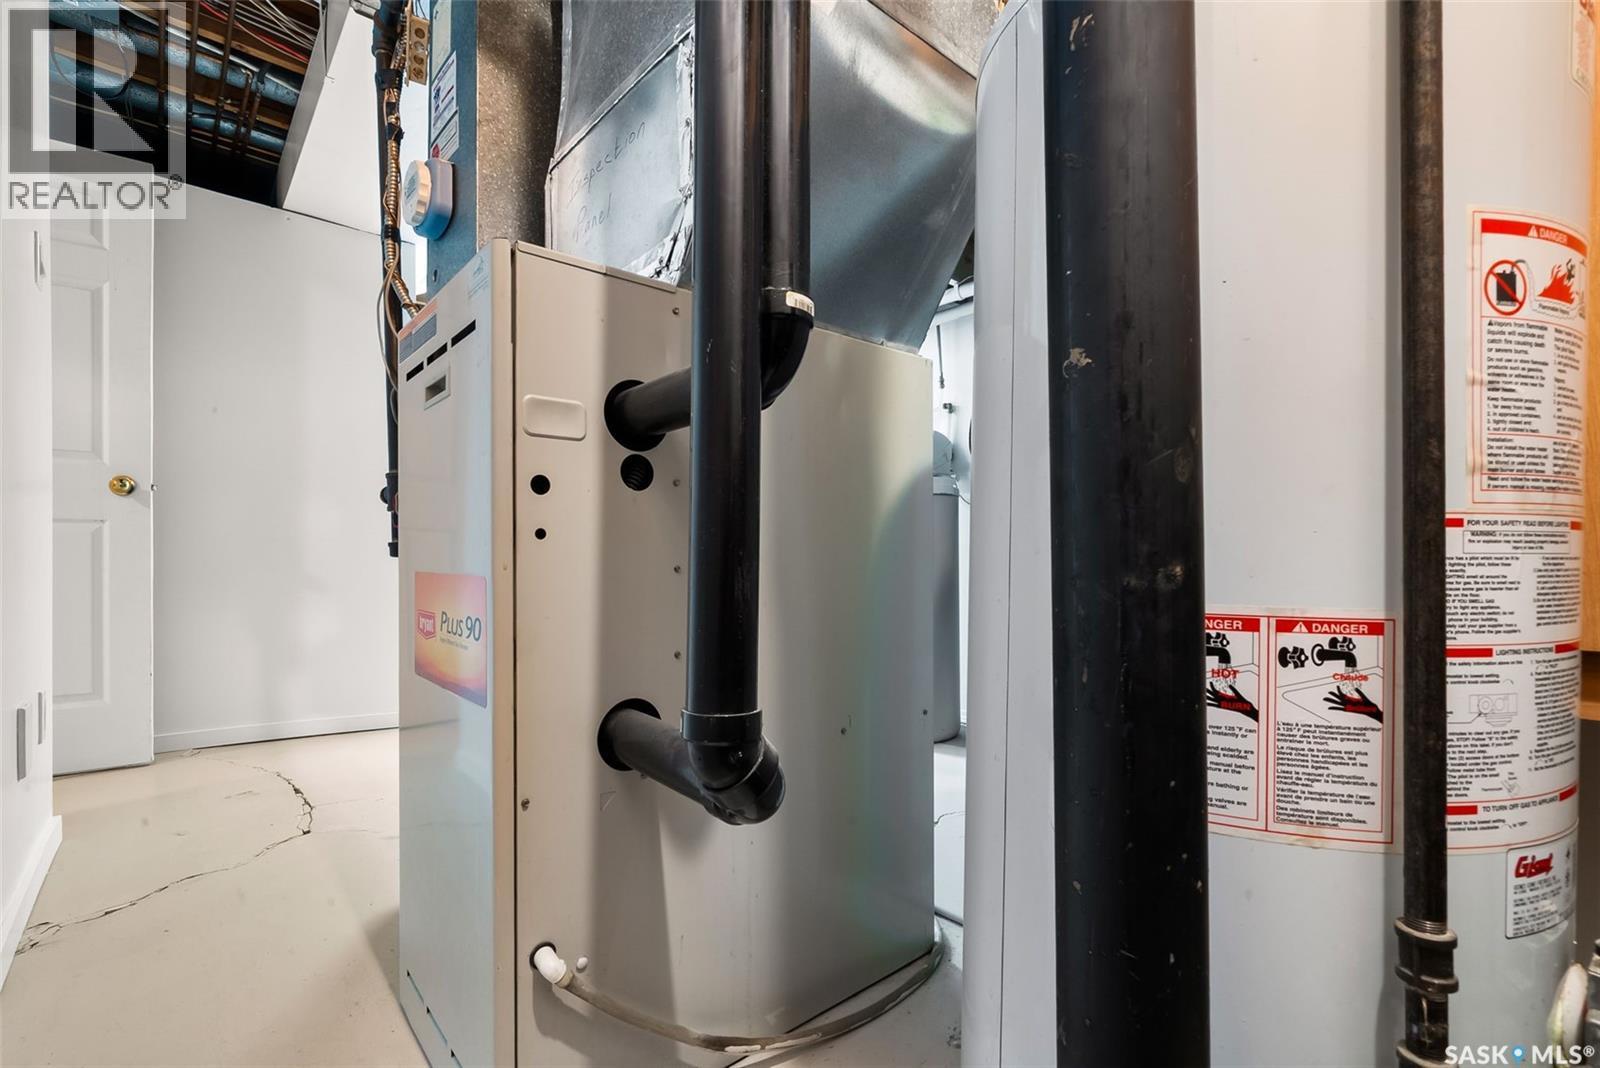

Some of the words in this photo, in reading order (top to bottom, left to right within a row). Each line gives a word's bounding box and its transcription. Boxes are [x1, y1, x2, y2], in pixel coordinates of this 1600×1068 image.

[574, 193, 612, 243] Panel
[1539, 227, 1568, 244] DANGER
[465, 615, 482, 642] 90
[1205, 619, 1243, 631] NGER
[1312, 622, 1368, 634] DANGER
[1211, 669, 1239, 679] HOT
[1221, 701, 1251, 711] BURN
[1212, 730, 1238, 738] instantly
[1216, 782, 1240, 791] bathing
[1276, 811, 1313, 819] température
